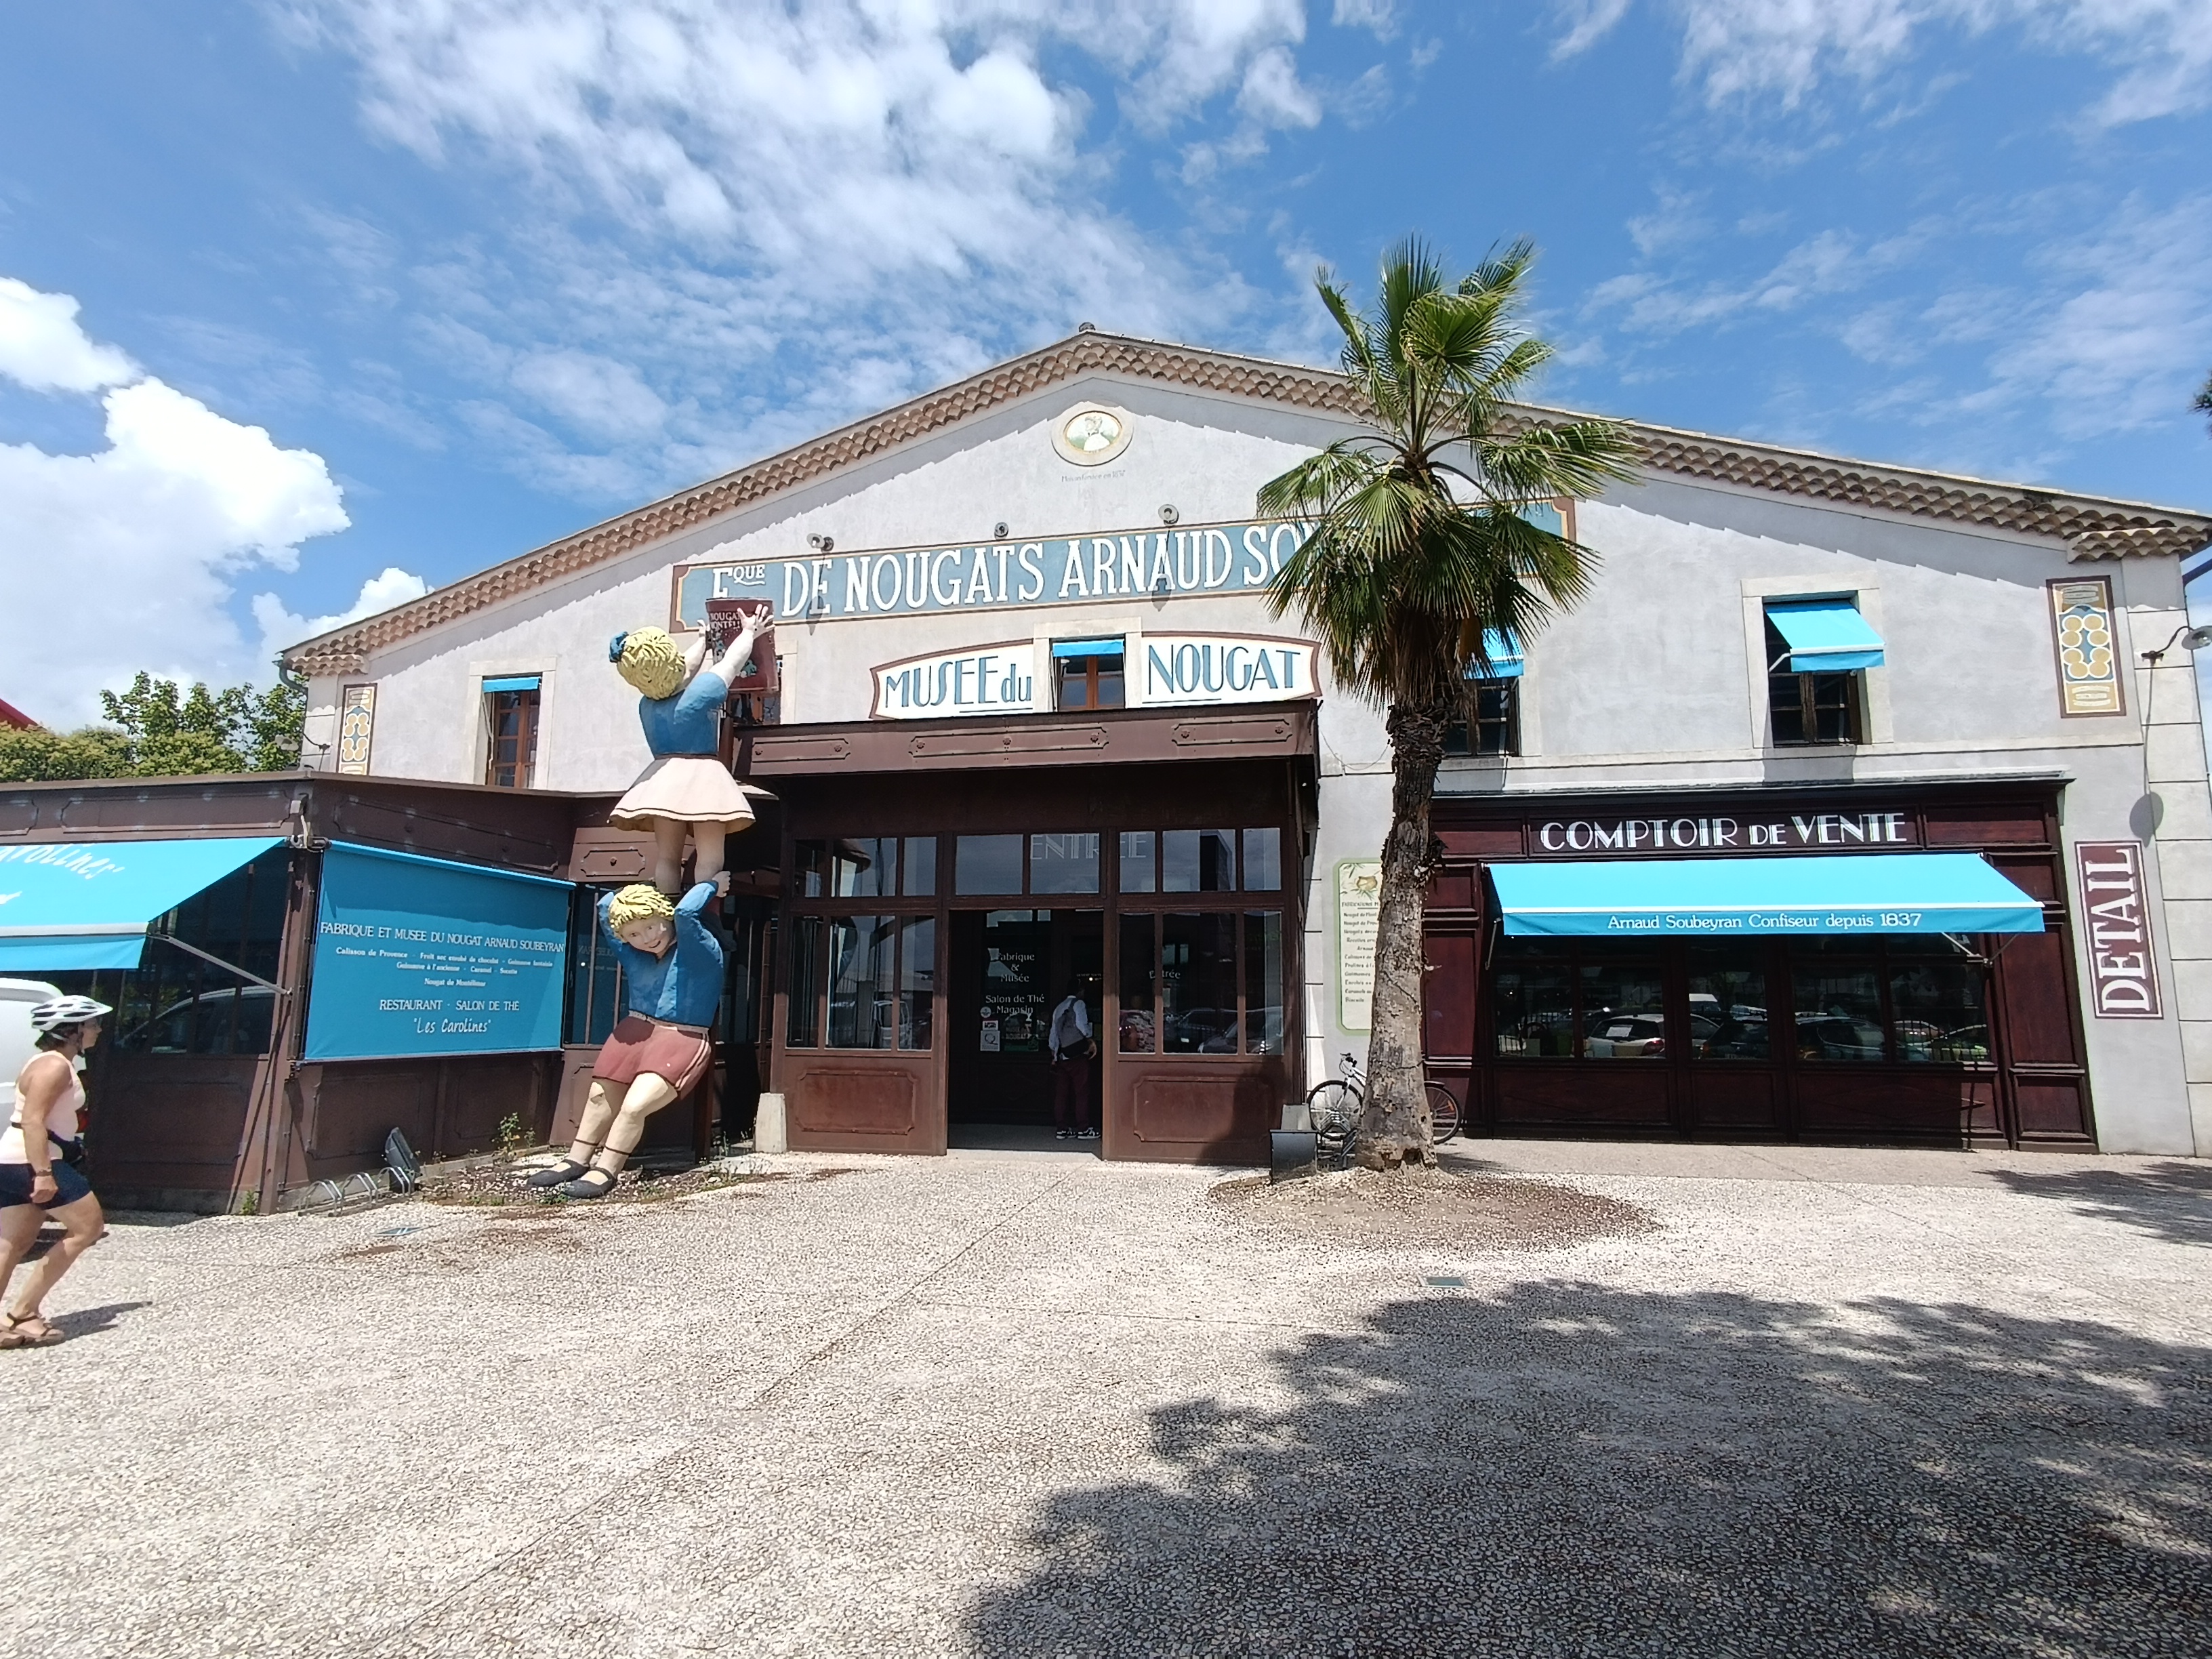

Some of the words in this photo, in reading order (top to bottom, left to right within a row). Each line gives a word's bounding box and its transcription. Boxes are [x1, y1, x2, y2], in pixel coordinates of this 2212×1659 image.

[781, 558, 832, 617] DE
[844, 542, 1044, 613] NOUGATS
[1058, 529, 1233, 598] ARNAUD
[885, 655, 1000, 708] MUSEE
[1001, 663, 1032, 703] du
[1148, 643, 1300, 695] NOUGAT
[1540, 817, 1738, 851] COMPTOIR
[1748, 824, 1787, 846] DE
[1791, 813, 1908, 844] VENTE
[1607, 914, 1662, 930] Arnaud
[1666, 914, 1742, 931] Soubeyran
[1748, 914, 1820, 929] Confiseur
[1825, 913, 1875, 930] depuis
[1880, 913, 1922, 926] 1837
[2086, 848, 2150, 1012] DETAIL
[320, 922, 374, 937] FABRIQUE
[378, 927, 392, 938] ET
[430, 932, 445, 943] DU
[447, 933, 483, 945] NOUGAT
[485, 937, 518, 949] ARNAUD
[519, 940, 564, 952] SOUBEYRAN
[336, 947, 365, 956] Calisson
[380, 949, 408, 958] Provence
[1010, 964, 1019, 972] &
[424, 978, 445, 986] Nougat
[1000, 973, 1029, 982] Musée
[985, 995, 1010, 1003] Salon
[1013, 995, 1025, 1003] de
[1027, 994, 1044, 1003] Thé
[380, 1000, 443, 1010] RESTAURANT
[455, 1000, 485, 1010] SALON
[489, 1001, 500, 1010] DE
[997, 1005, 1033, 1015] Magasin
